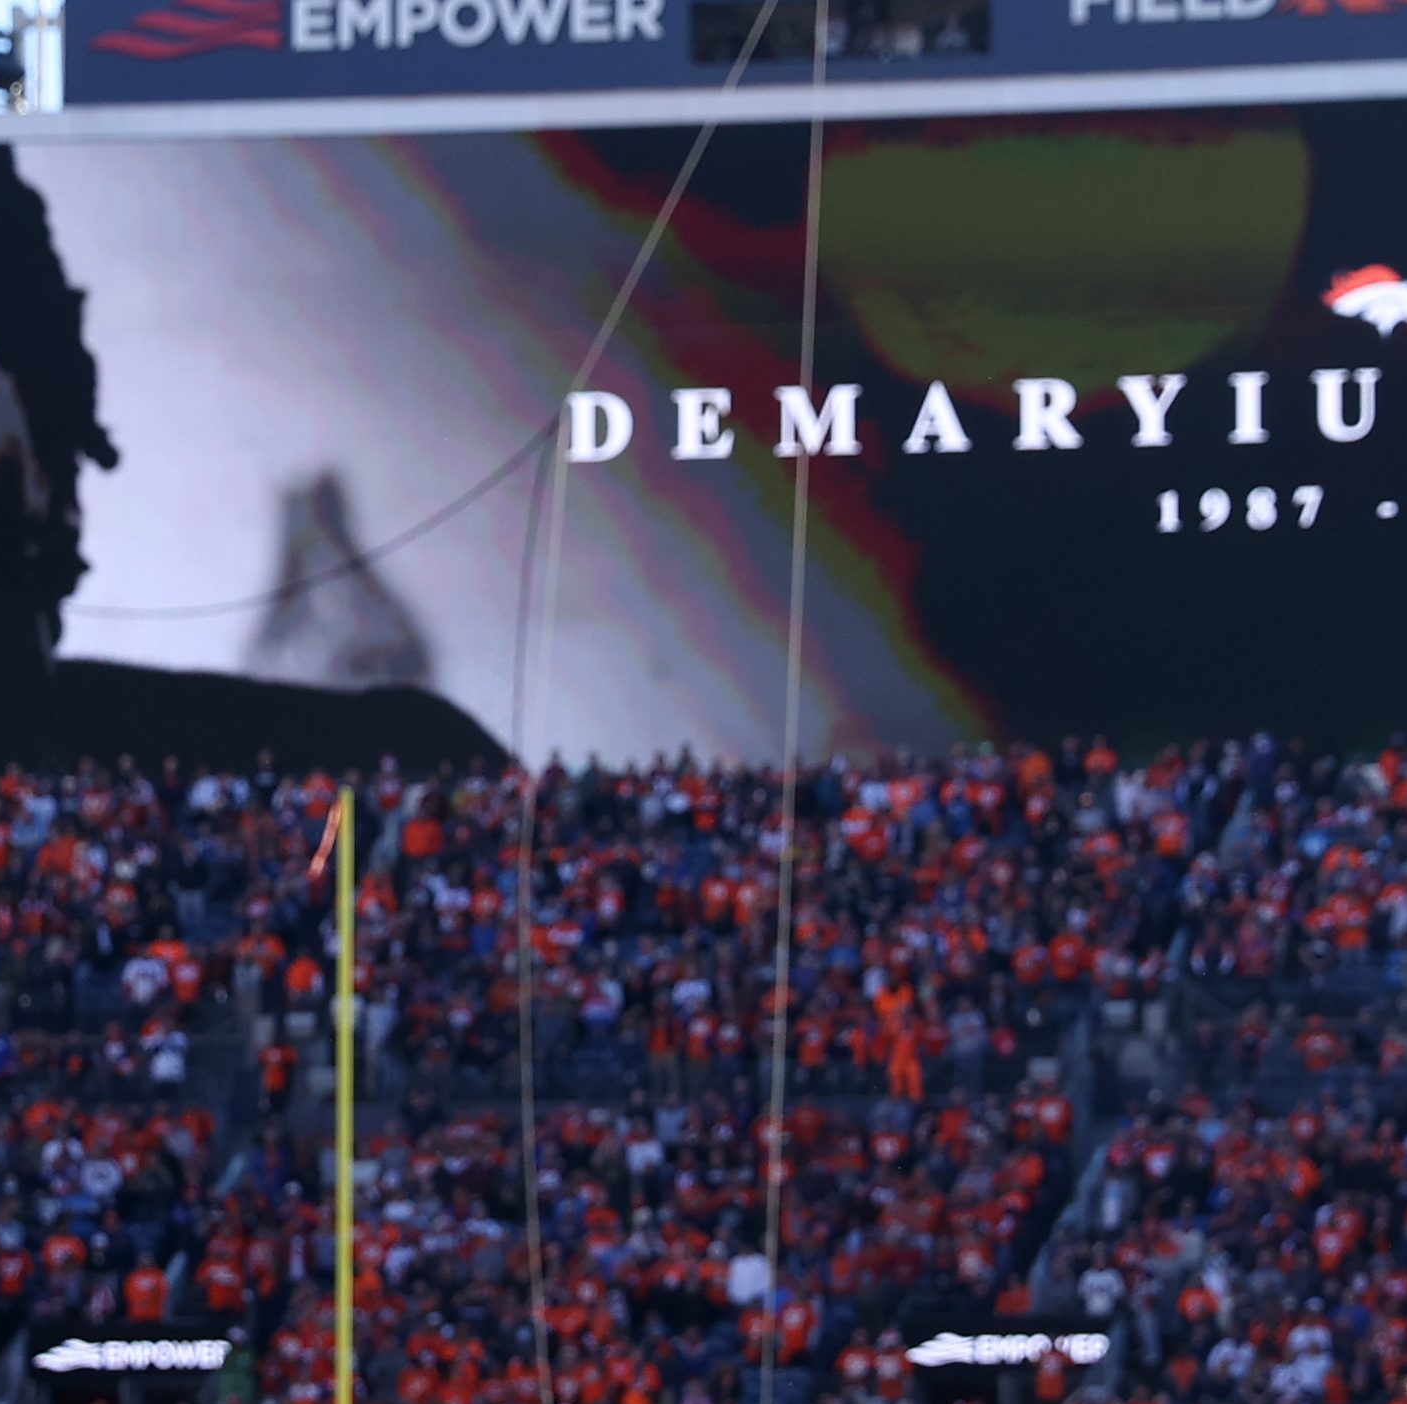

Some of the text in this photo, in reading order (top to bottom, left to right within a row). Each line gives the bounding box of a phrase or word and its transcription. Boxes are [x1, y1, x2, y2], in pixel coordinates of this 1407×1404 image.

[291, 0, 665, 51] EMPOWER
[1157, 484, 1325, 534] 1987
[974, 1333, 1110, 1365] EMPOER
